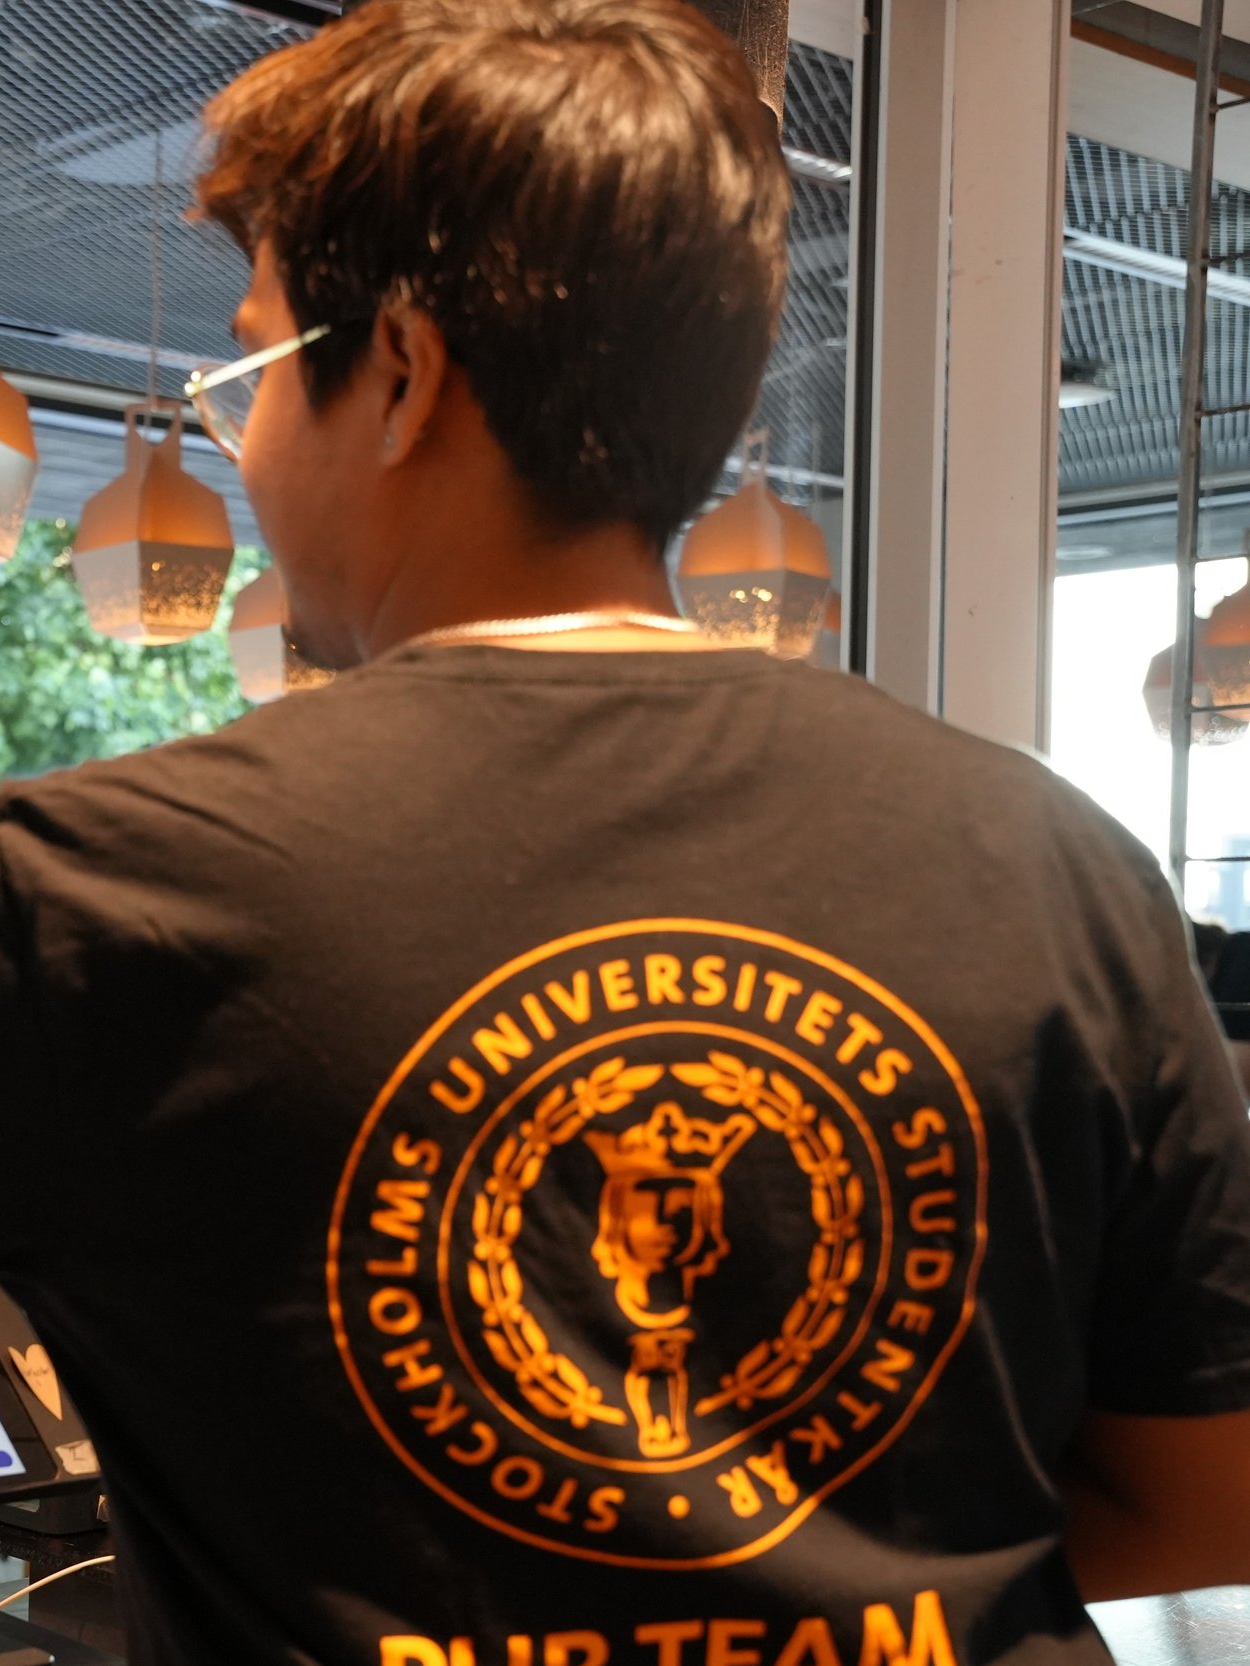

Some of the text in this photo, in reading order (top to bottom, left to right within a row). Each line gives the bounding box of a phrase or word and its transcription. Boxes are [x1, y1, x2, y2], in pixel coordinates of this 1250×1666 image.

[366, 953, 956, 1532] STOCKHOLMS UNIVERSITETS STUDENTKÅR
[634, 1590, 961, 1666] TEAM
